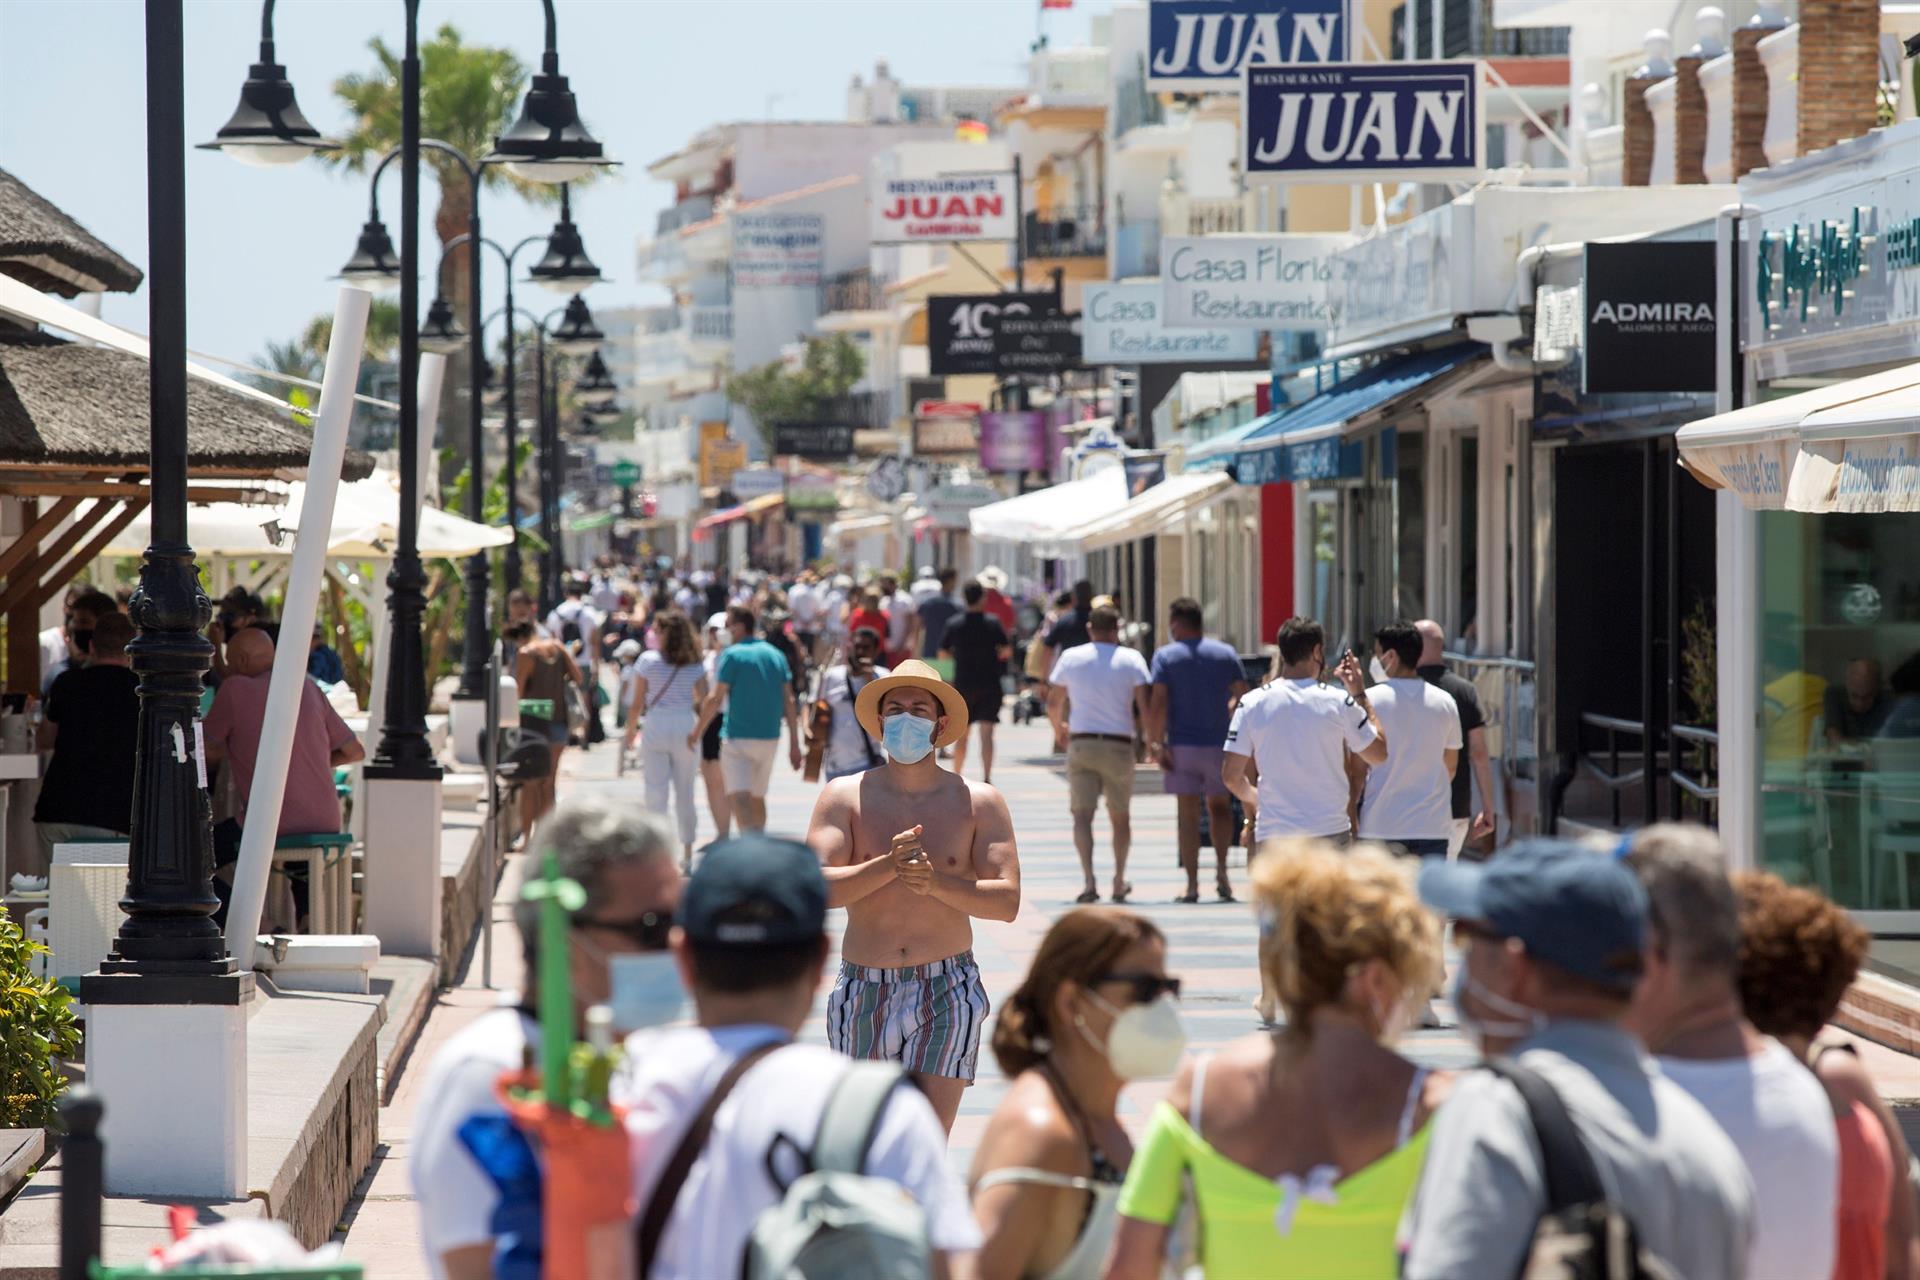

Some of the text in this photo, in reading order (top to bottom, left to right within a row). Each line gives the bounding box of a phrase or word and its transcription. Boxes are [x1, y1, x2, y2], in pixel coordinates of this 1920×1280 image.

[1153, 12, 1340, 75] JUAN
[1253, 73, 1344, 85] RESTAURANTE
[1254, 91, 1464, 163] JUAN
[882, 193, 1004, 220] JUAN
[1170, 246, 1247, 282] Casa
[1089, 291, 1157, 323] Casa
[1592, 300, 1714, 324] ADMIRA
[1110, 328, 1230, 351] Restaurante
[1618, 323, 1715, 332] SALONES DE JUEGO
